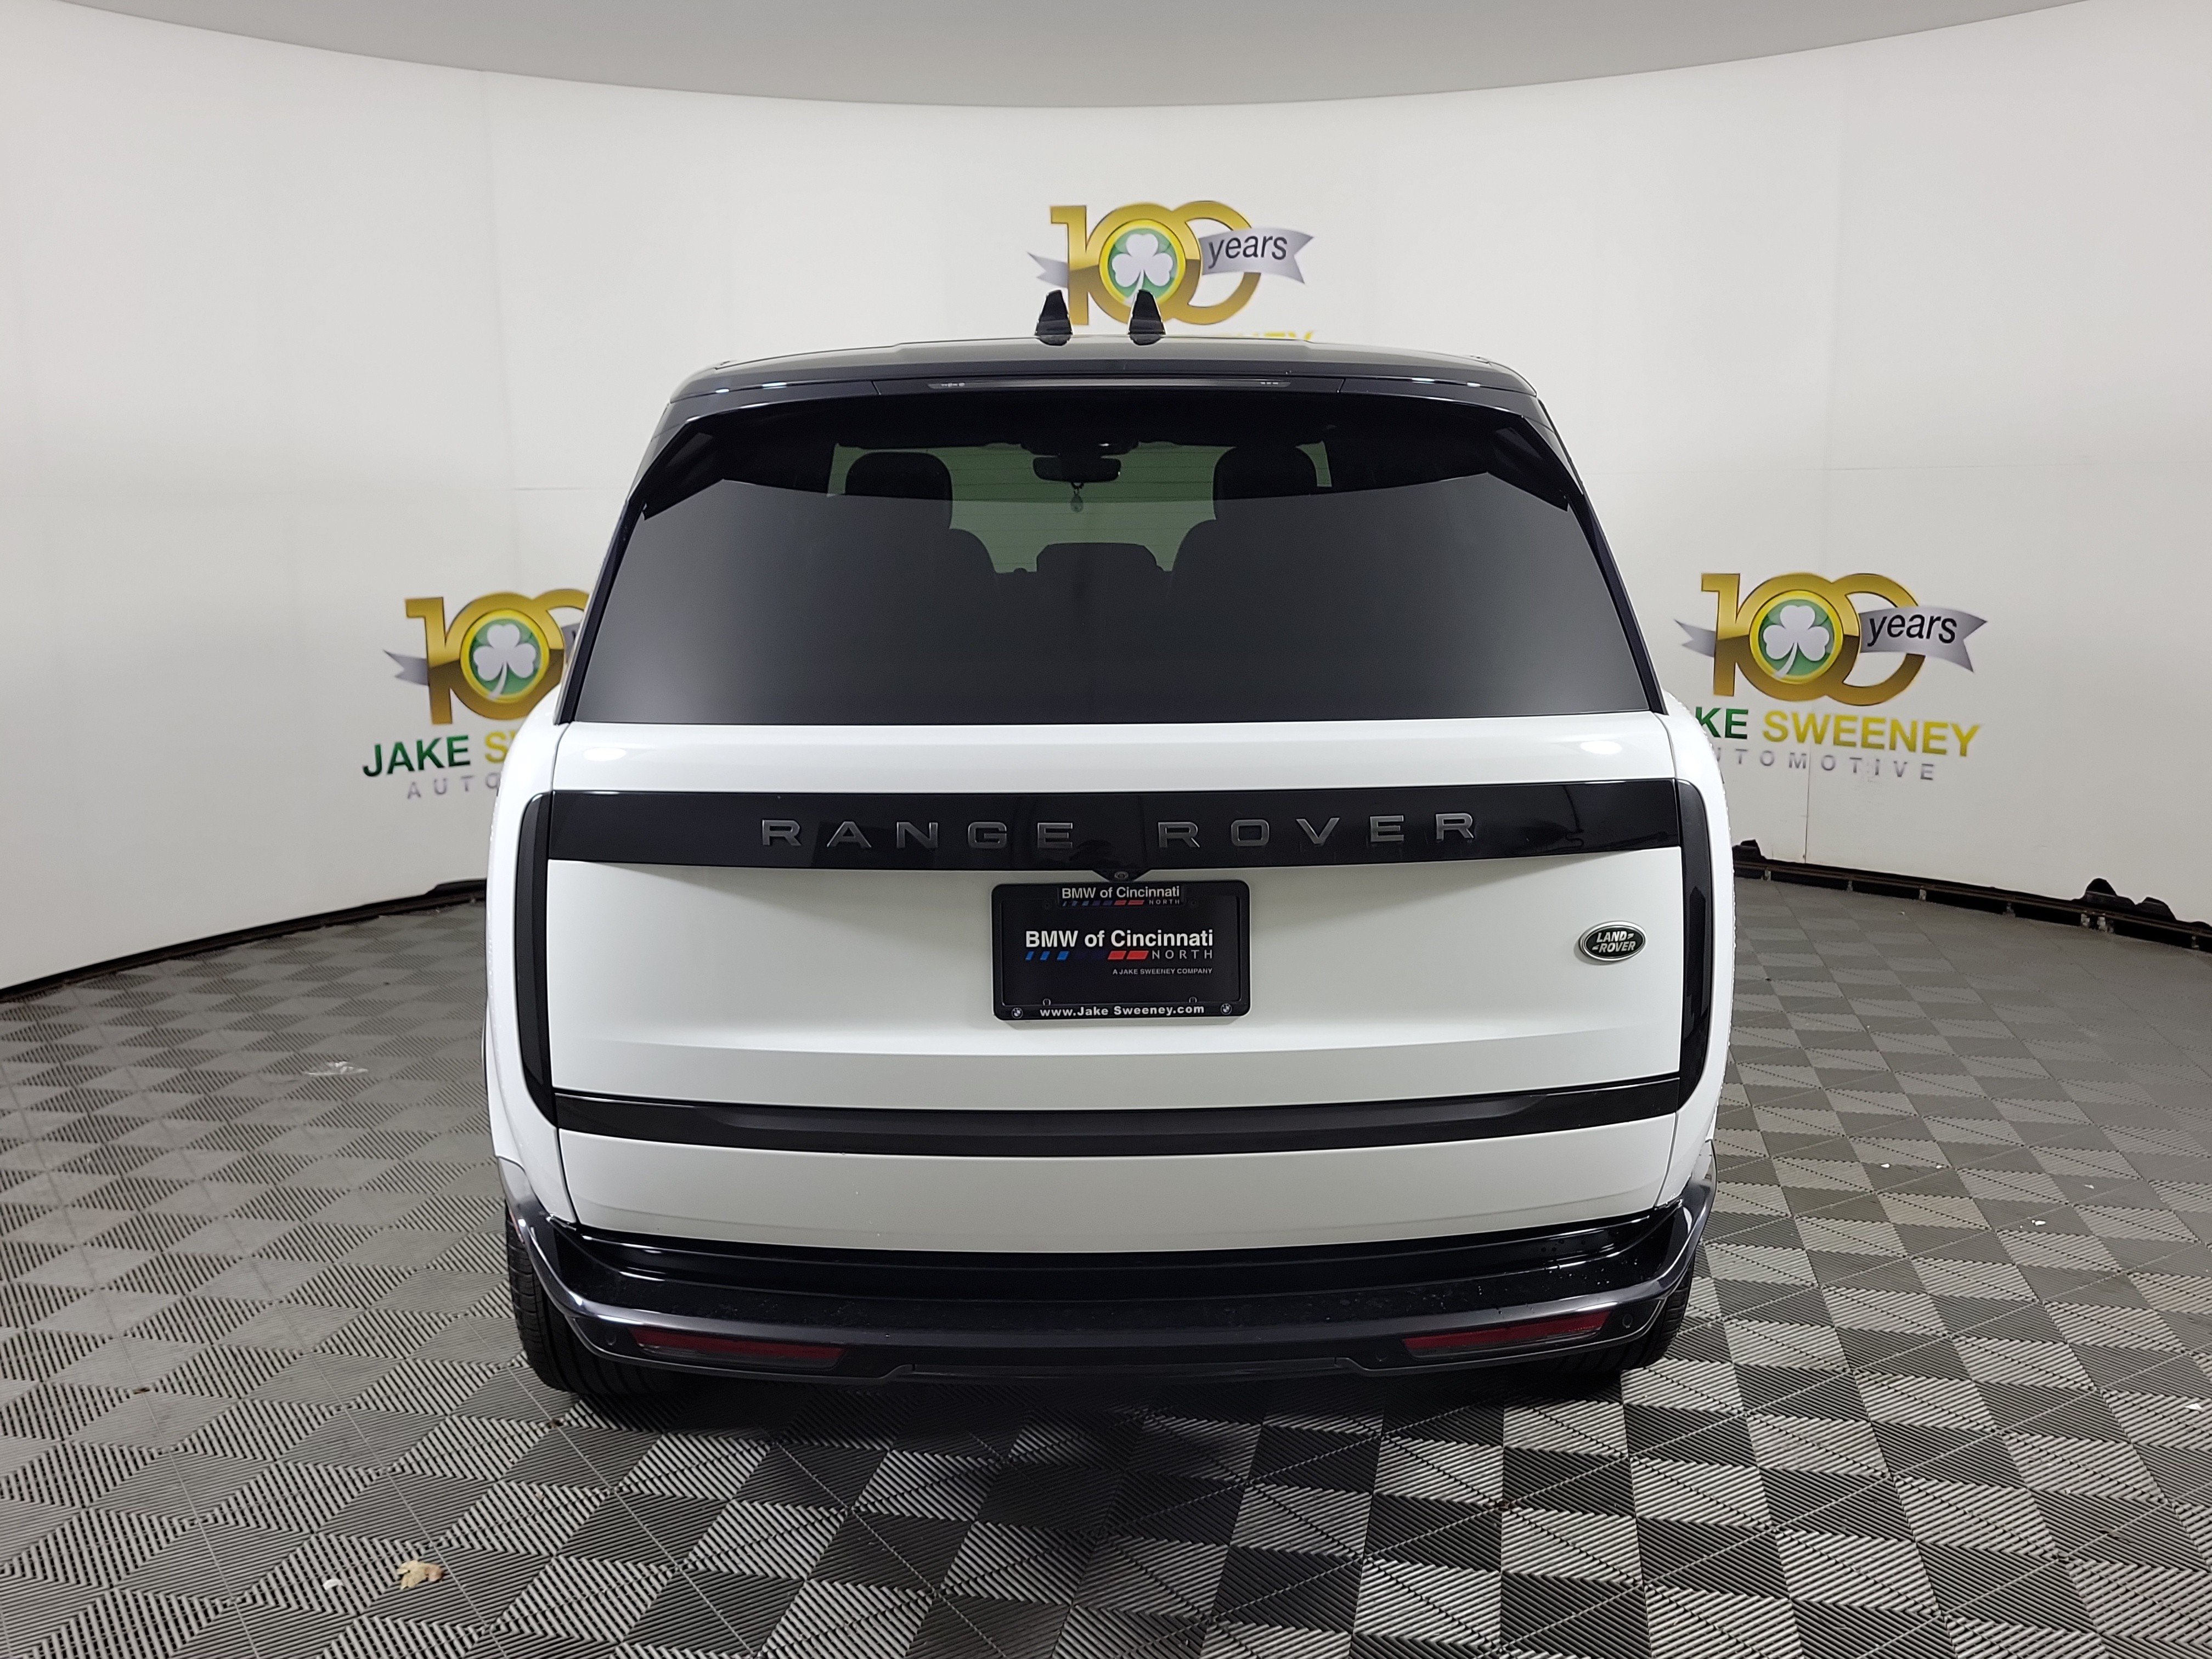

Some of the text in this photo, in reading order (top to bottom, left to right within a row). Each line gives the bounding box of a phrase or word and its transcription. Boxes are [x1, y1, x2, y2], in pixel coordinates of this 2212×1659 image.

[1209, 235, 1288, 269] years
[1701, 572, 1957, 706] 100 years
[1695, 706, 1980, 757] KE SWEENEY
[363, 736, 471, 777] JAKE
[761, 812, 1475, 849] RANGE ROVER
[1062, 885, 1180, 898] BMW of Cincinnati
[1025, 929, 1213, 947] BMW of Cincinnati
[1596, 931, 1627, 943] LAND
[1152, 950, 1212, 960] NORTH
[1599, 941, 1636, 953] ROVER
[1040, 1005, 1204, 1017] www.Jake Sweeney.com
